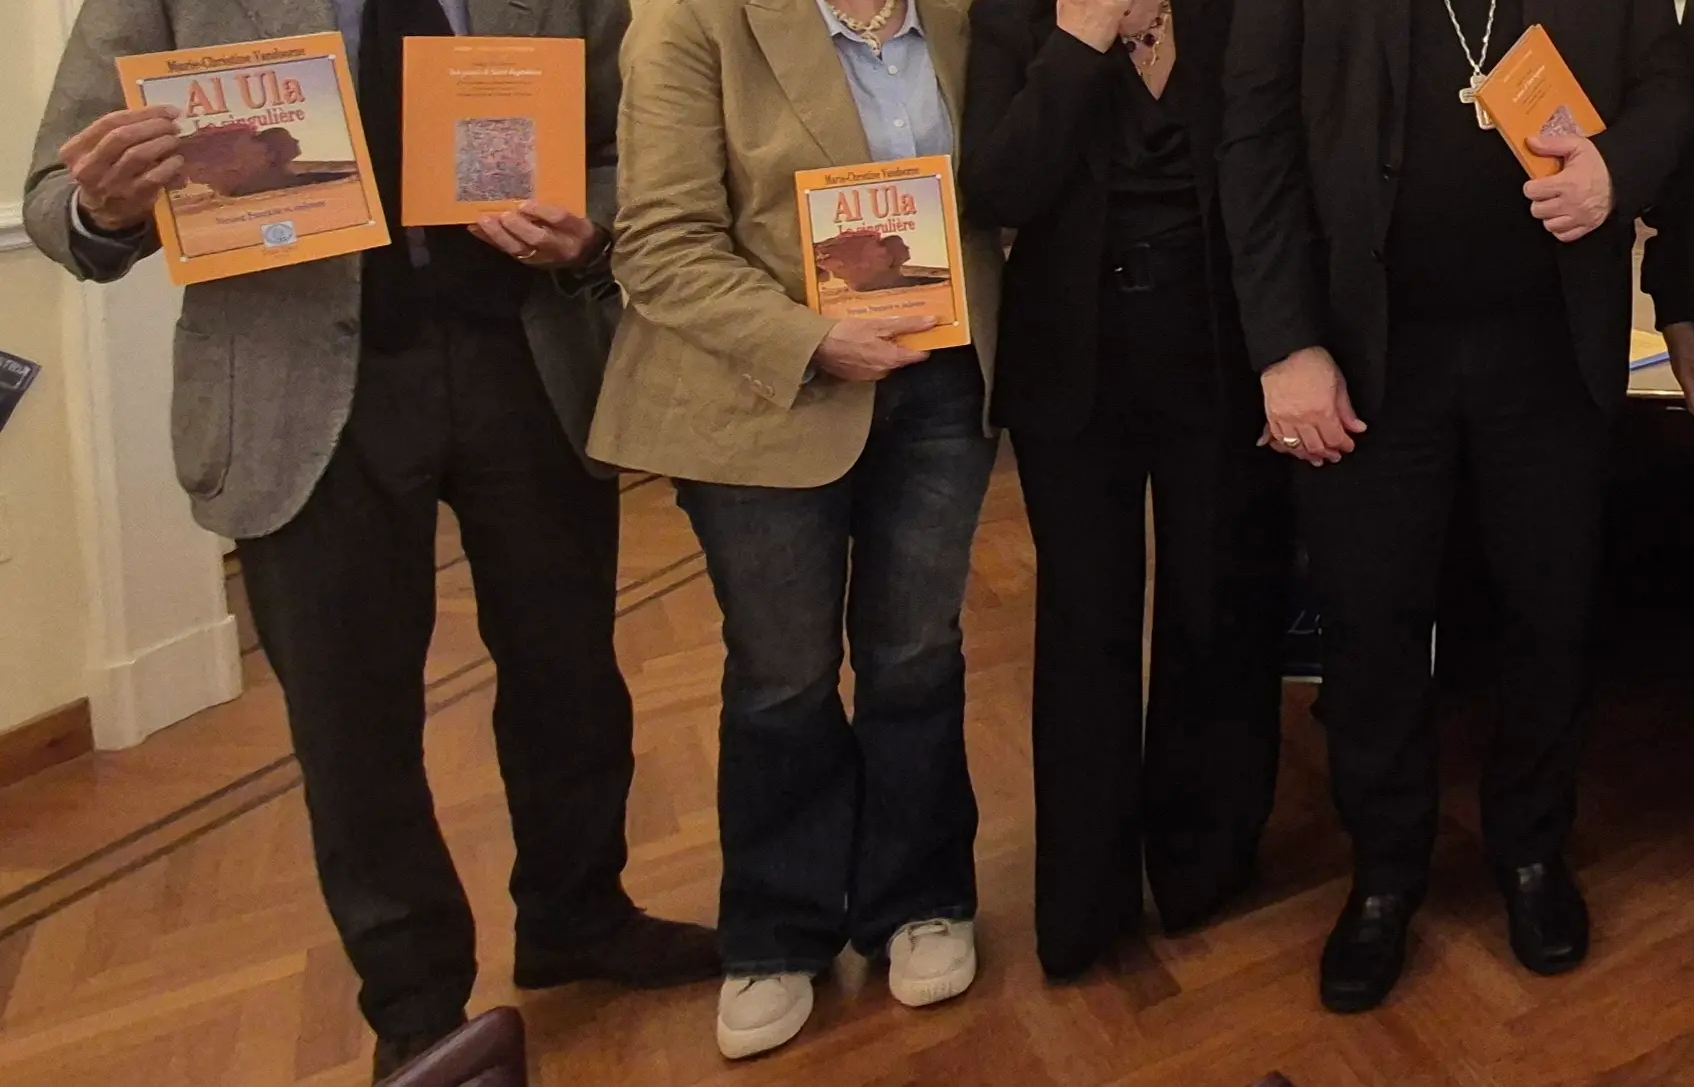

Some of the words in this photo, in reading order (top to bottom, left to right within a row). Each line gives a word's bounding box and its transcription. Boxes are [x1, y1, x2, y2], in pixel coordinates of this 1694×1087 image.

[186, 77, 229, 118] Al
[235, 69, 305, 109] Ula
[833, 190, 863, 223] Al
[868, 185, 917, 218] Ula
